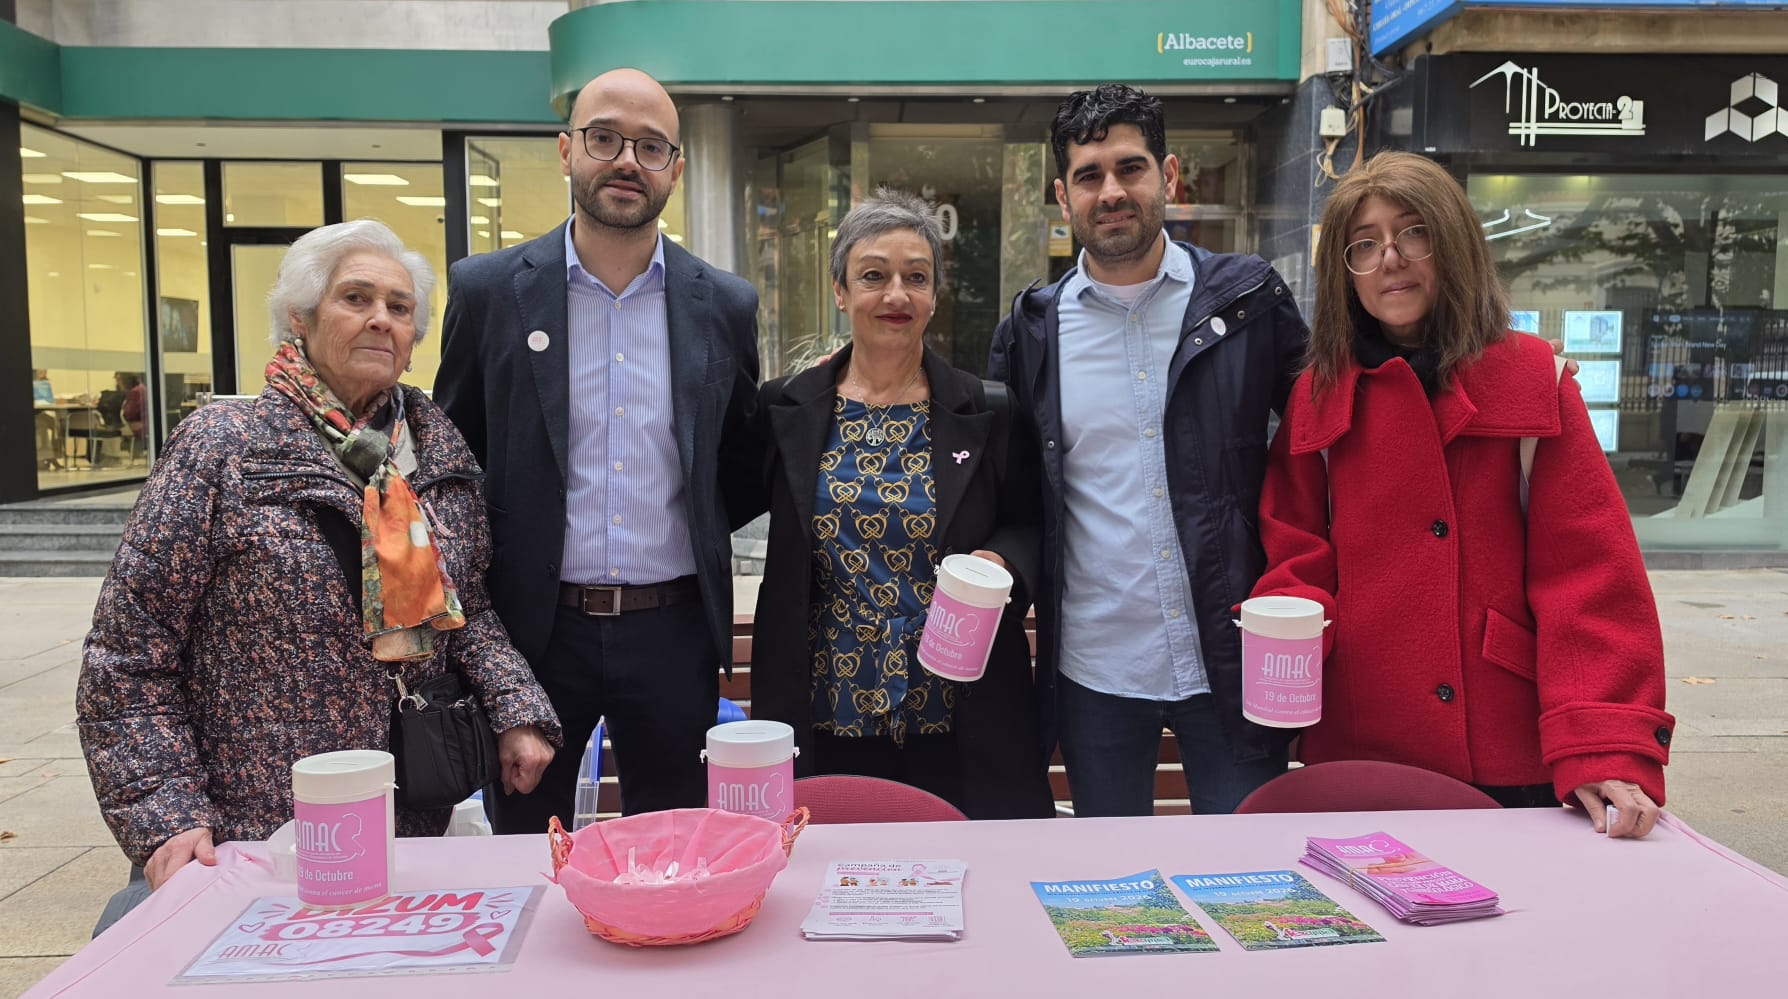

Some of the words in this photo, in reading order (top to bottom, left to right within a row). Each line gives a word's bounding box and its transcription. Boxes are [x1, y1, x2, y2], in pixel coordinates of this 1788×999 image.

[929, 601, 966, 638] AMAC
[1261, 652, 1313, 679] AMAC
[1265, 690, 1275, 702] 19
[1277, 692, 1287, 703] de
[718, 782, 771, 811] AMAC
[305, 867, 313, 880] de
[315, 869, 354, 882] Octubre
[1185, 873, 1294, 888] MANIFIESTO
[1043, 879, 1155, 894] MANIFIESTO
[278, 914, 464, 939] 08249
[218, 943, 292, 958] AMAC
